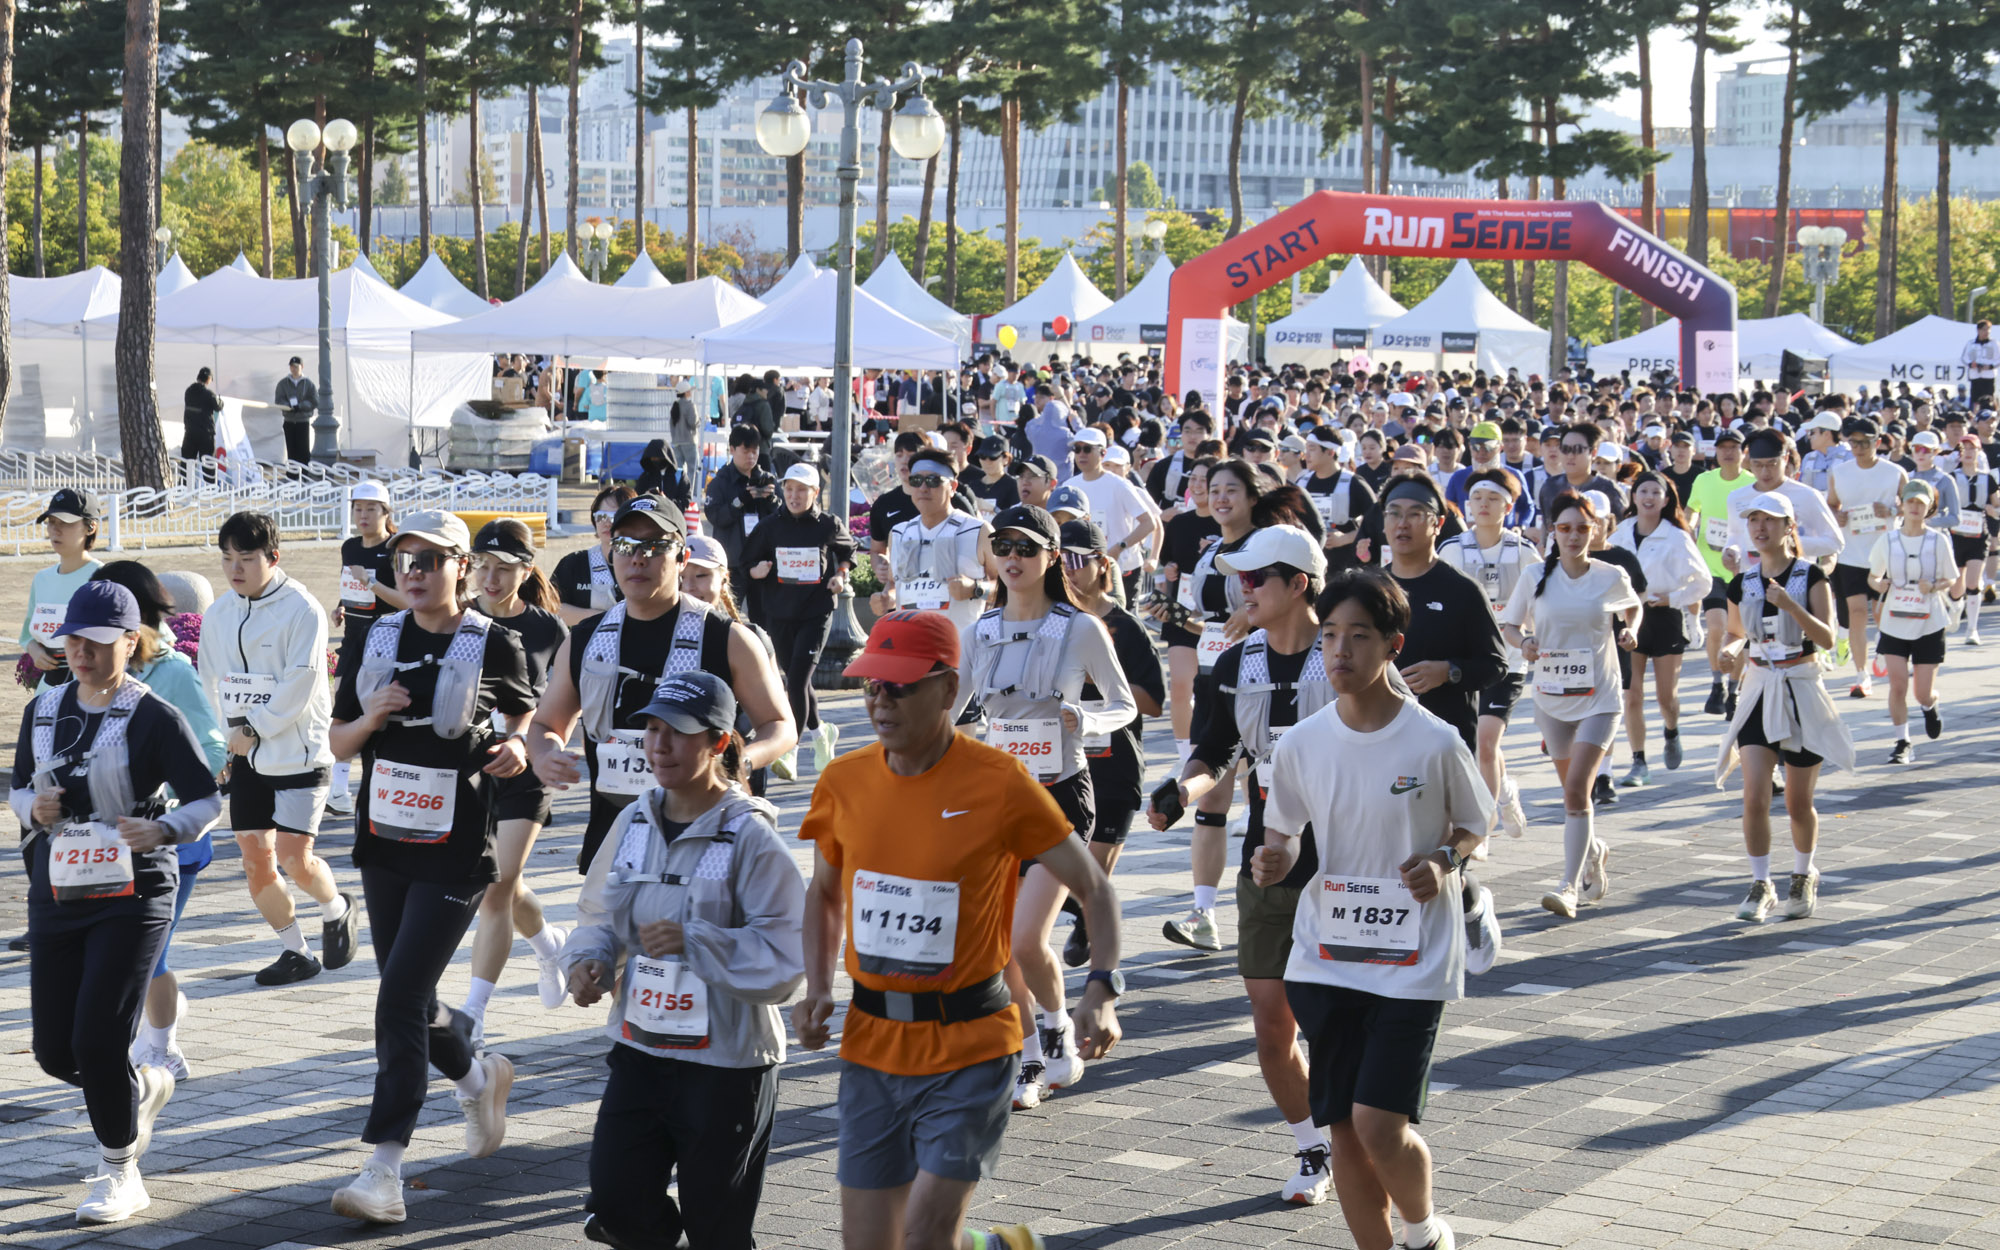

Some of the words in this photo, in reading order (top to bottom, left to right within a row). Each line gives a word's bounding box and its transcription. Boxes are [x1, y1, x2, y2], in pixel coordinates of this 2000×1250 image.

[1226, 218, 1319, 288] START
[1607, 227, 1705, 302] FINISH
[1628, 358, 1680, 373] PRES
[1891, 363, 1924, 380] MC
[789, 560, 815, 568] 2242
[1554, 664, 1587, 675] 1198
[223, 692, 231, 701] M
[234, 692, 272, 705] 1729
[1003, 723, 1029, 732] SENSE
[1008, 741, 1052, 756] 2265
[376, 763, 391, 777] Run
[391, 767, 421, 781] SENSE
[607, 758, 617, 770] M
[377, 787, 389, 801] W
[391, 789, 445, 811] 2266
[63, 828, 92, 838] SENSE
[54, 851, 64, 863] W
[67, 846, 119, 865] 2153
[855, 876, 876, 892] Run
[876, 880, 913, 897] SENSE
[1324, 880, 1345, 892] Run
[1346, 881, 1380, 895] SENSE
[860, 908, 874, 923] M
[880, 909, 943, 936] 1134
[1331, 906, 1346, 920] M
[1352, 906, 1410, 926] 1837
[640, 988, 694, 1011] 2155
